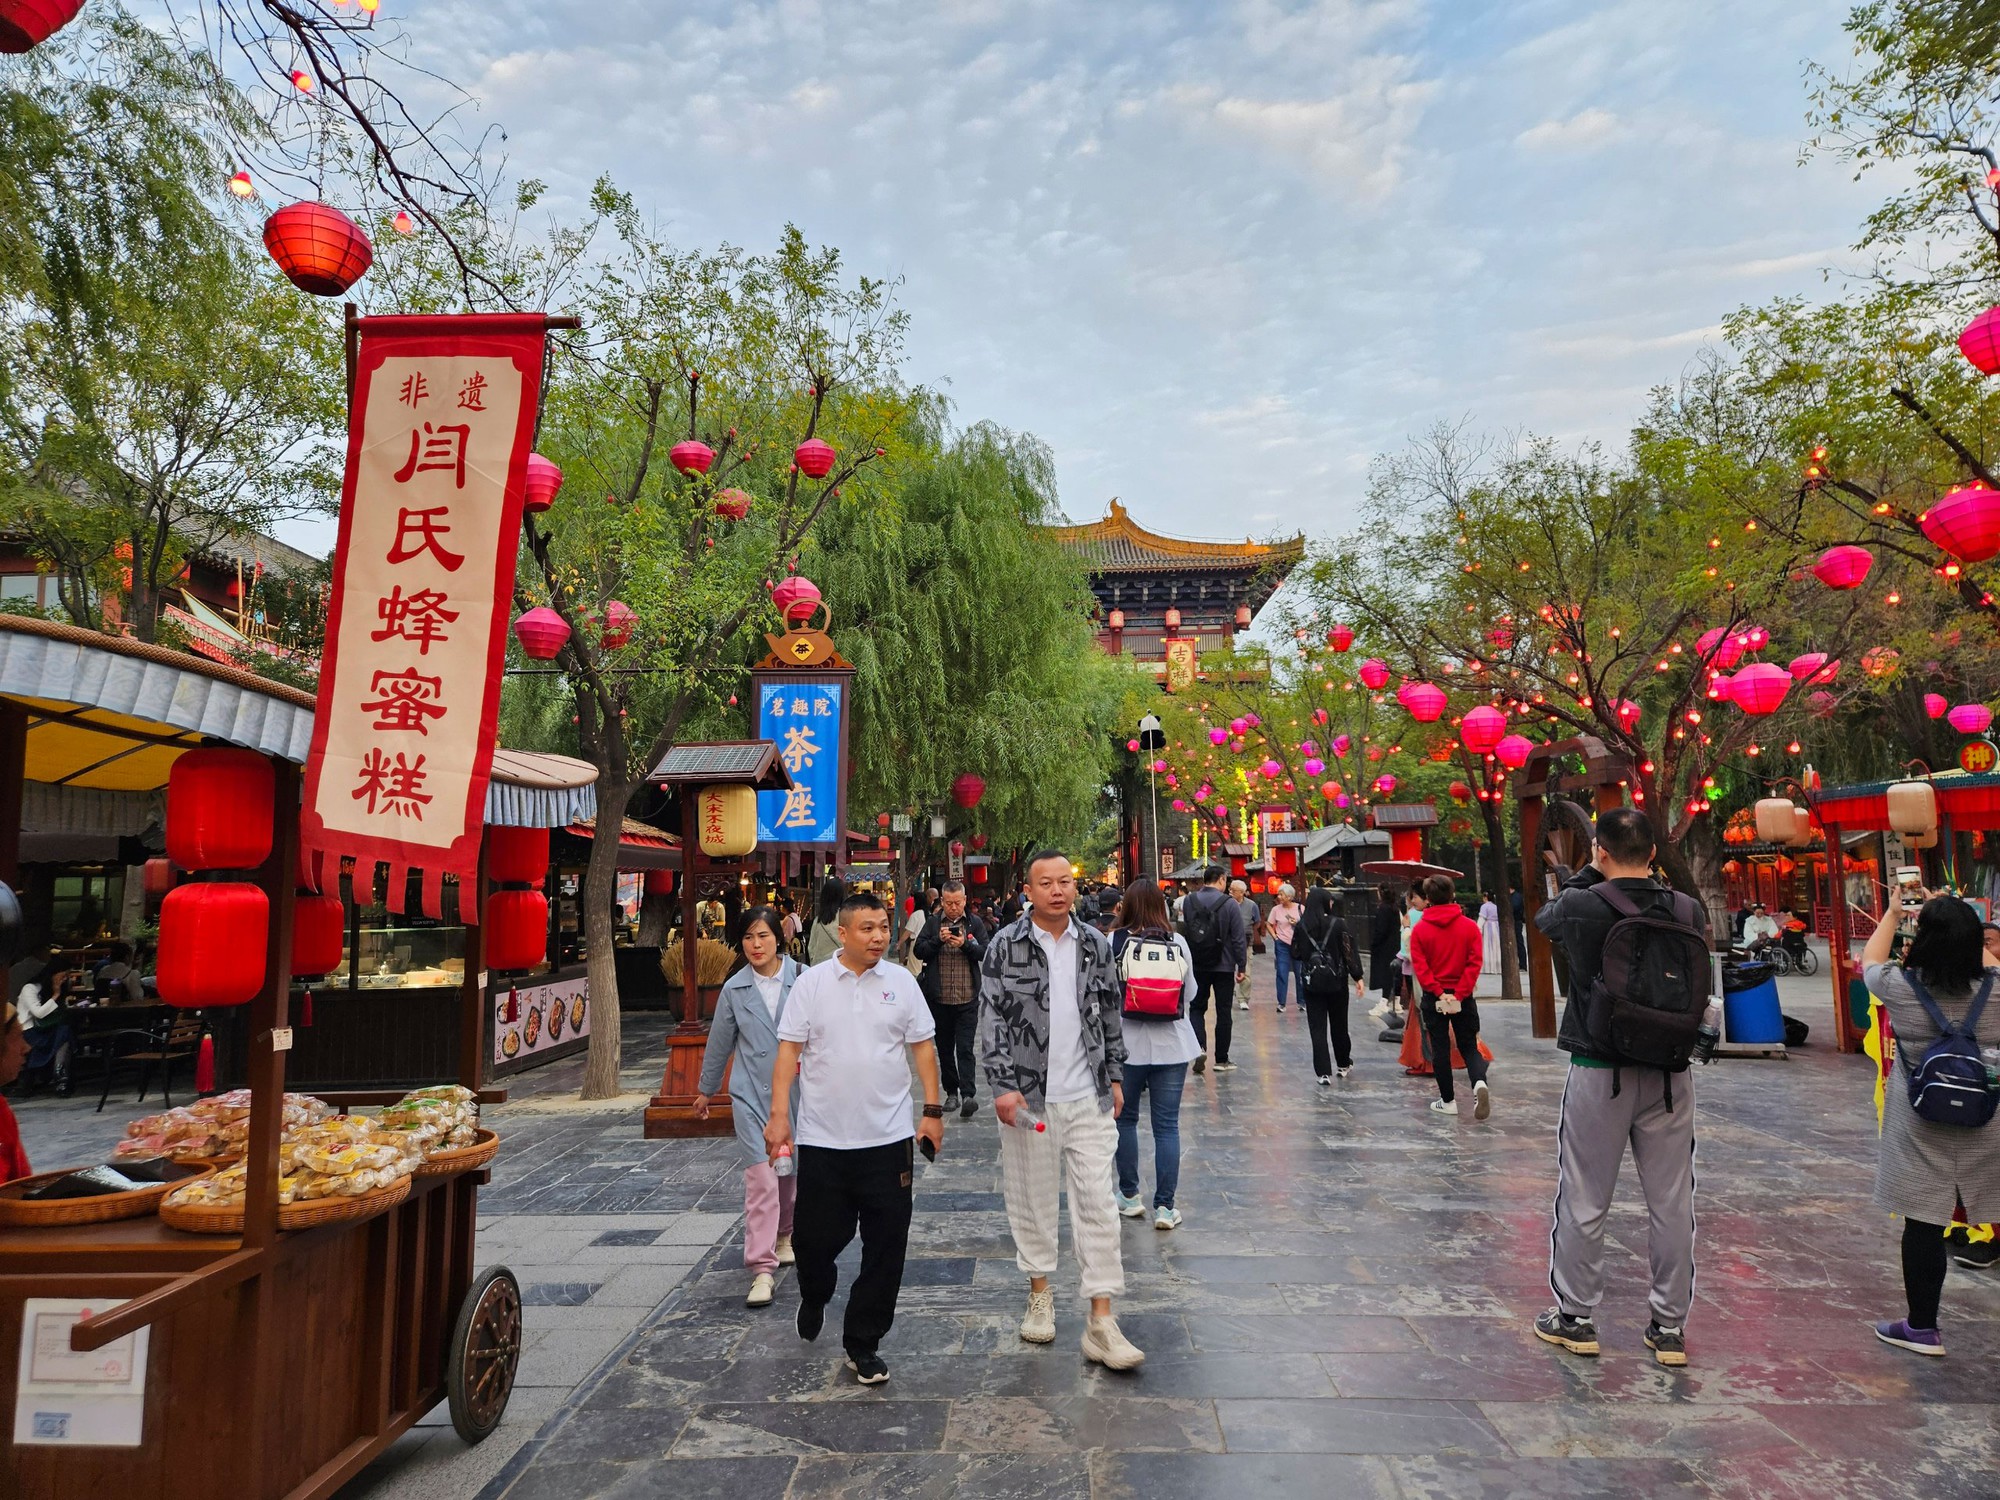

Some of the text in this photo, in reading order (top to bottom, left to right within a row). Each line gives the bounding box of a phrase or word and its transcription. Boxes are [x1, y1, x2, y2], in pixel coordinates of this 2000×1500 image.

[399, 370, 489, 411] 非遗
[351, 421, 471, 822] 闫氏蜂蜜糕
[795, 643, 810, 655] 茶
[1173, 646, 1189, 684] 吉祥
[769, 697, 832, 717] 茗趣院
[774, 725, 822, 829] 茶座
[1965, 745, 1991, 770] 神
[705, 792, 727, 845] 大宋不夜城
